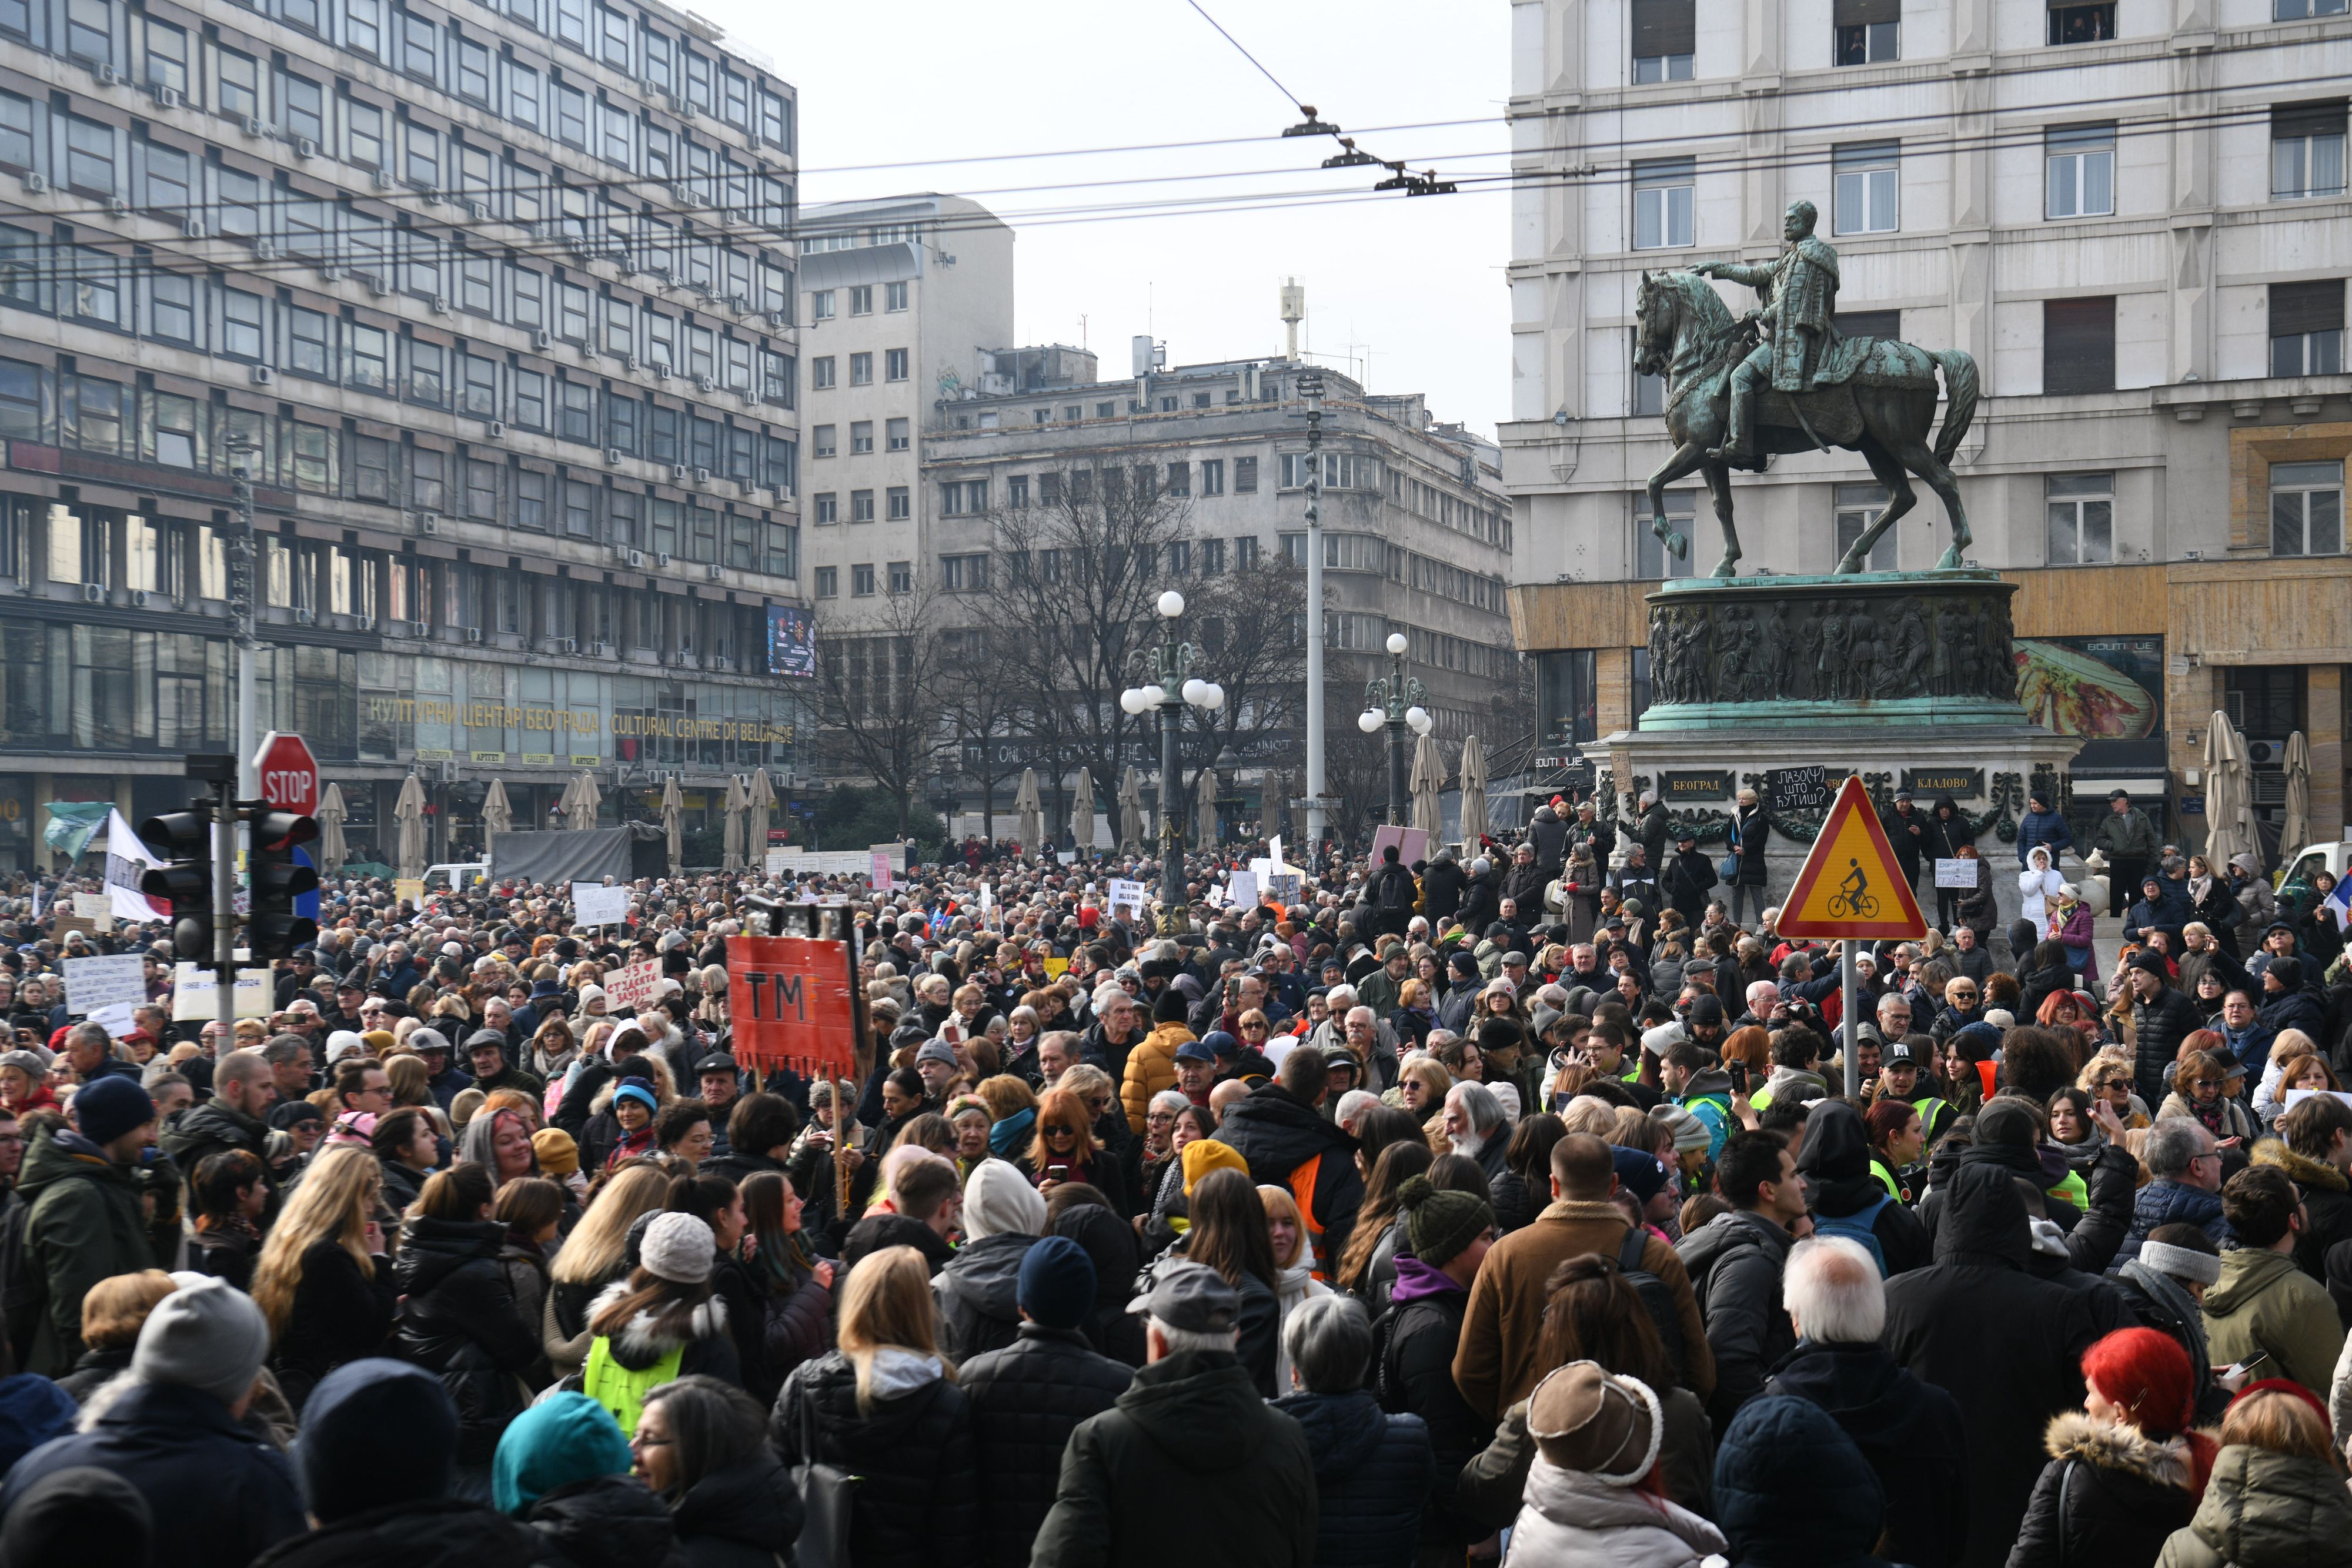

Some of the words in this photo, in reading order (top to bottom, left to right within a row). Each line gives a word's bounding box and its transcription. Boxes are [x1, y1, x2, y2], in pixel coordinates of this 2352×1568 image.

[2087, 642, 2153, 651] BOUTIQUE
[370, 697, 458, 725] КУЛТУРНИ
[462, 704, 522, 731] ЦЕНТАР
[526, 708, 600, 737] БЕОГРАДА
[610, 714, 673, 737] CULTURAL
[676, 718, 720, 740] CENTRE
[723, 721, 737, 741] OF
[740, 723, 793, 744] BELGRADE
[1535, 757, 1583, 768] BOUTIQUE
[265, 770, 312, 804] STOP
[1673, 780, 1719, 791] БЕОГРАД
[1784, 783, 1808, 794] ШТО
[1917, 778, 1967, 789] КЛАДОВО
[1776, 787, 1826, 808] ЋУТИШ?
[1936, 877, 1976, 886] СТУДЕНТЕ
[743, 971, 823, 1024] TMF
